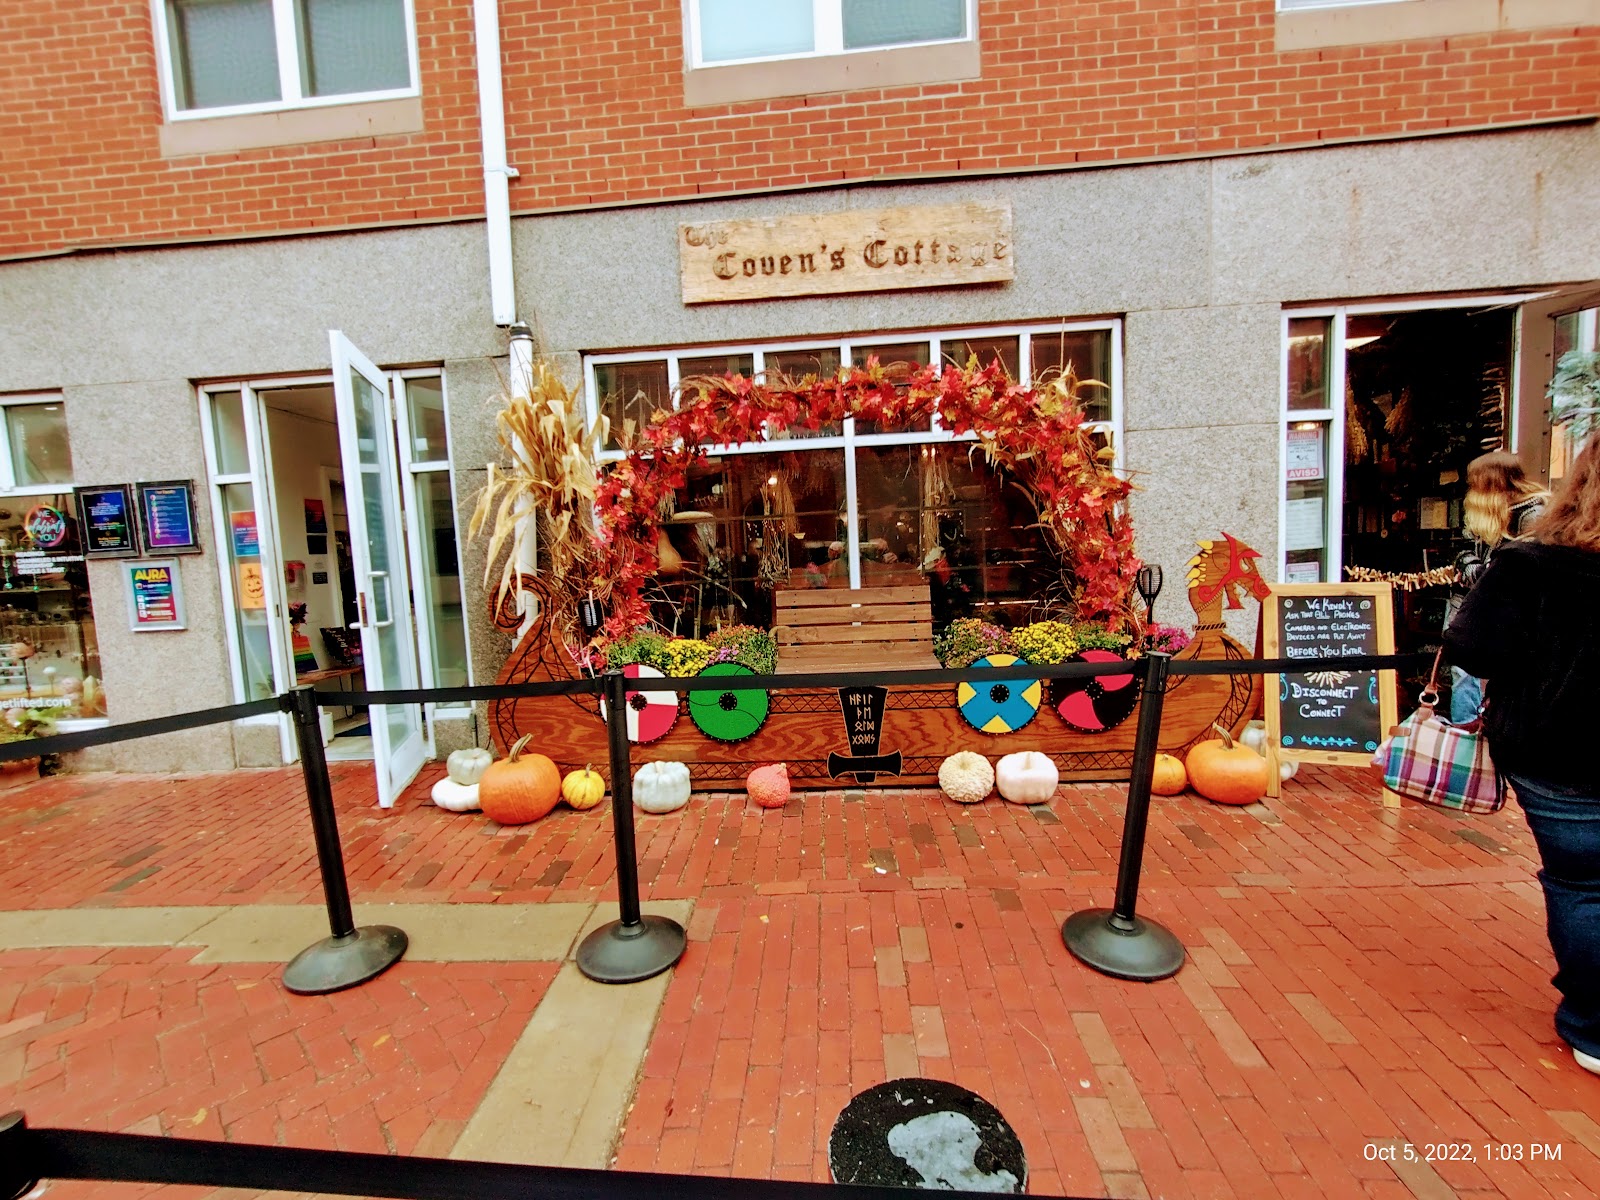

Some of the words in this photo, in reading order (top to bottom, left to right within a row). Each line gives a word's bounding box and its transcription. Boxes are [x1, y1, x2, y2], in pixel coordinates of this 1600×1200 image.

[713, 244, 846, 280] Coven's
[863, 237, 1007, 268] Cottage
[1290, 469, 1318, 477] AVISO
[36, 510, 51, 518] WE
[135, 569, 168, 580] AURA
